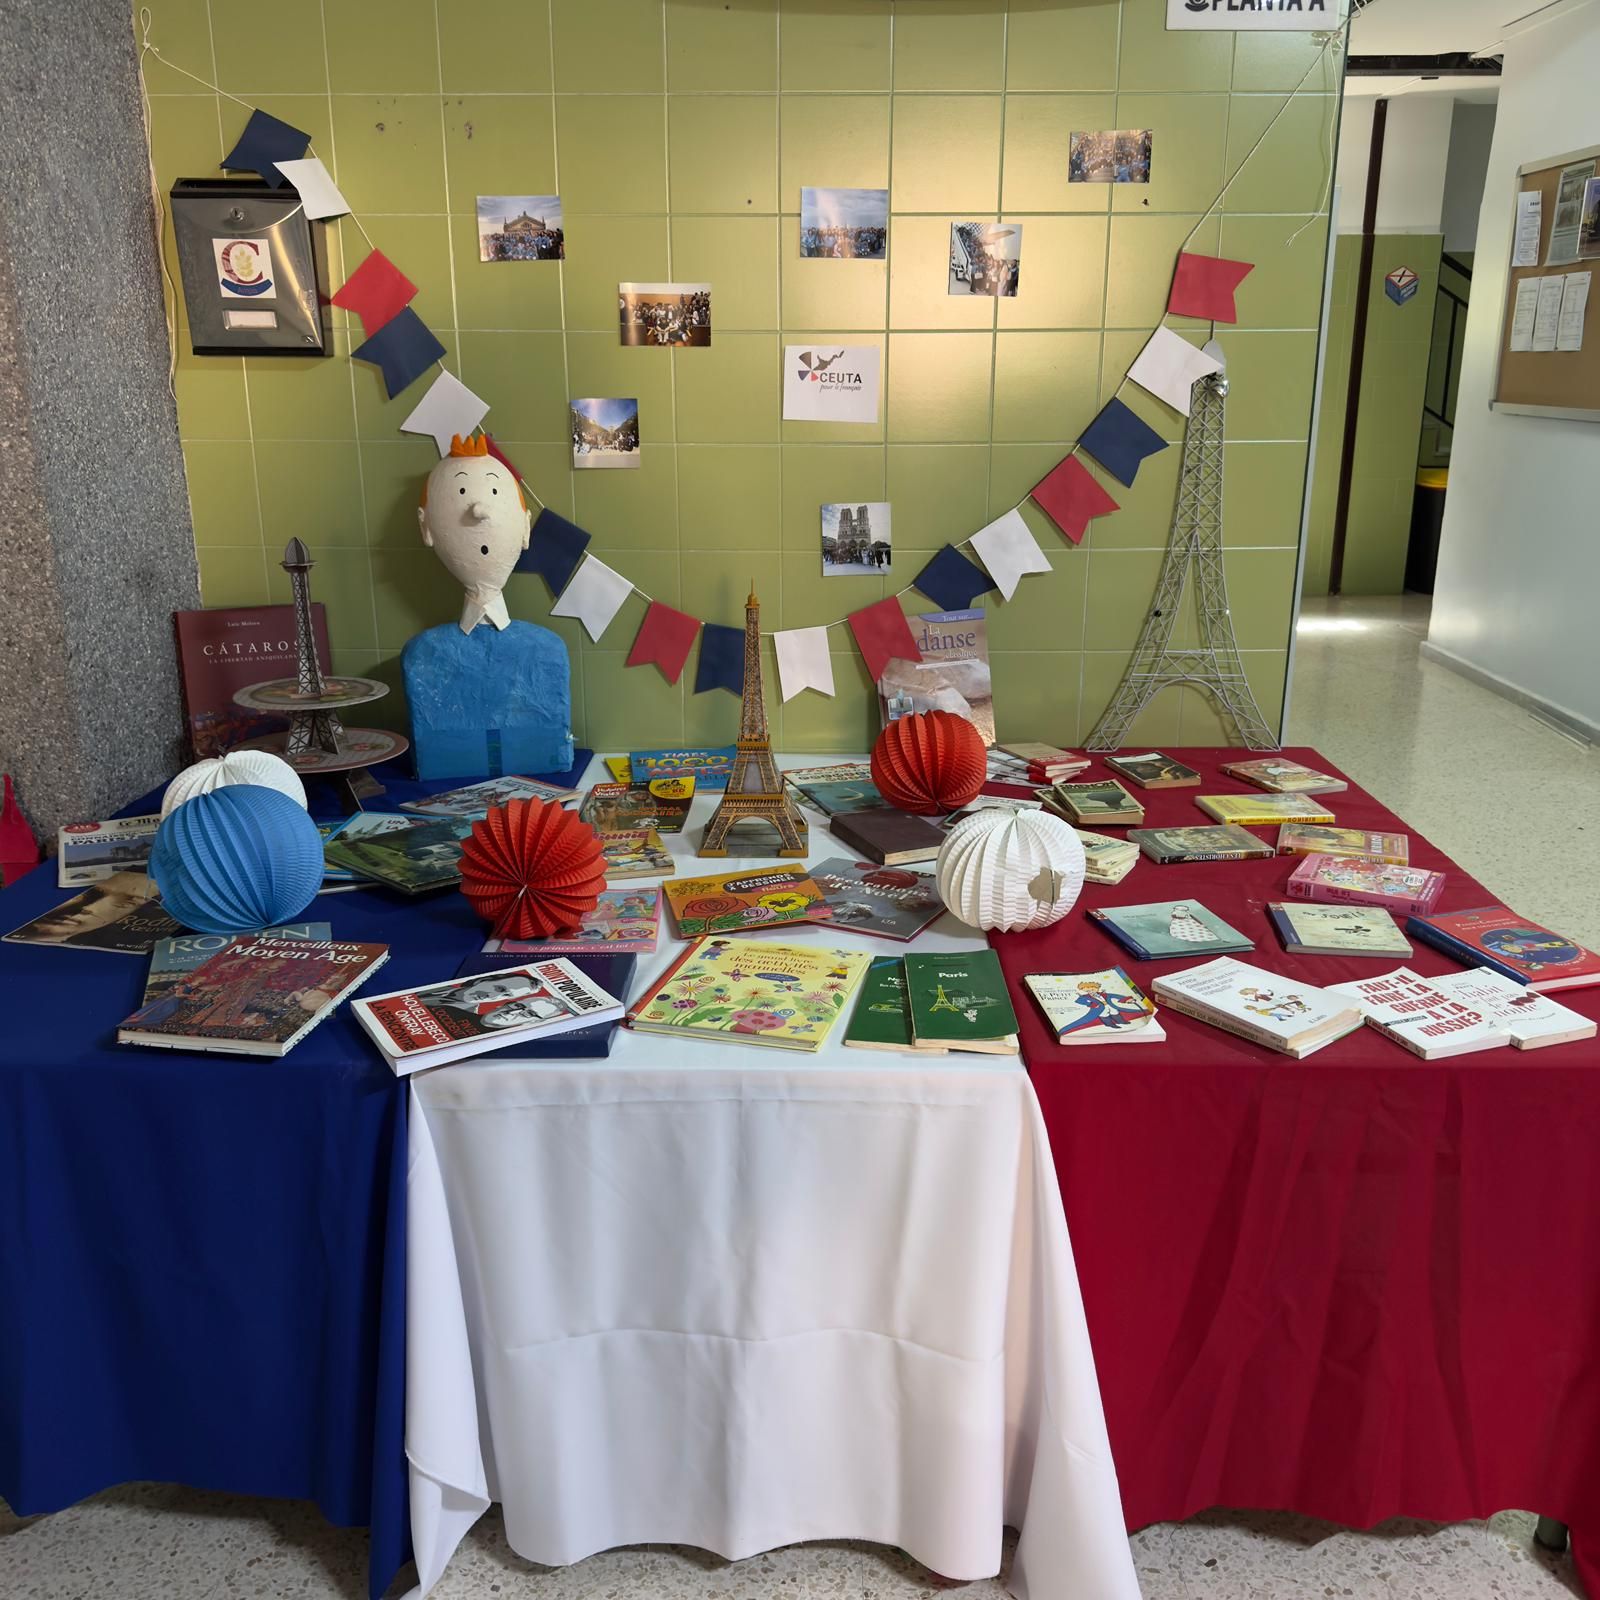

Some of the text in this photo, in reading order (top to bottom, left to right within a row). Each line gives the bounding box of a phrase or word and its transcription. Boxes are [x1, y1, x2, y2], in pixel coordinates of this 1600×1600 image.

[820, 372, 862, 384] CEUTA
[928, 624, 940, 635] La
[917, 628, 976, 652] danse
[741, 875, 796, 889] DESSINER
[829, 882, 853, 890] de
[169, 925, 310, 955] ROEN
[254, 937, 363, 952] Merveilleux
[225, 944, 311, 960] Moyen
[313, 949, 369, 964] Age
[734, 963, 806, 975] manuelles
[1356, 974, 1417, 994] FAUT-IL
[1363, 983, 1433, 1006] FAIRE LA
[1389, 992, 1451, 1014] GUERRE
[1440, 1001, 1470, 1016] LA
[395, 1009, 426, 1036] ONFRAY
[400, 994, 450, 1044] HOUELLEBECQ
[1417, 1010, 1484, 1037] RUSSIE?
